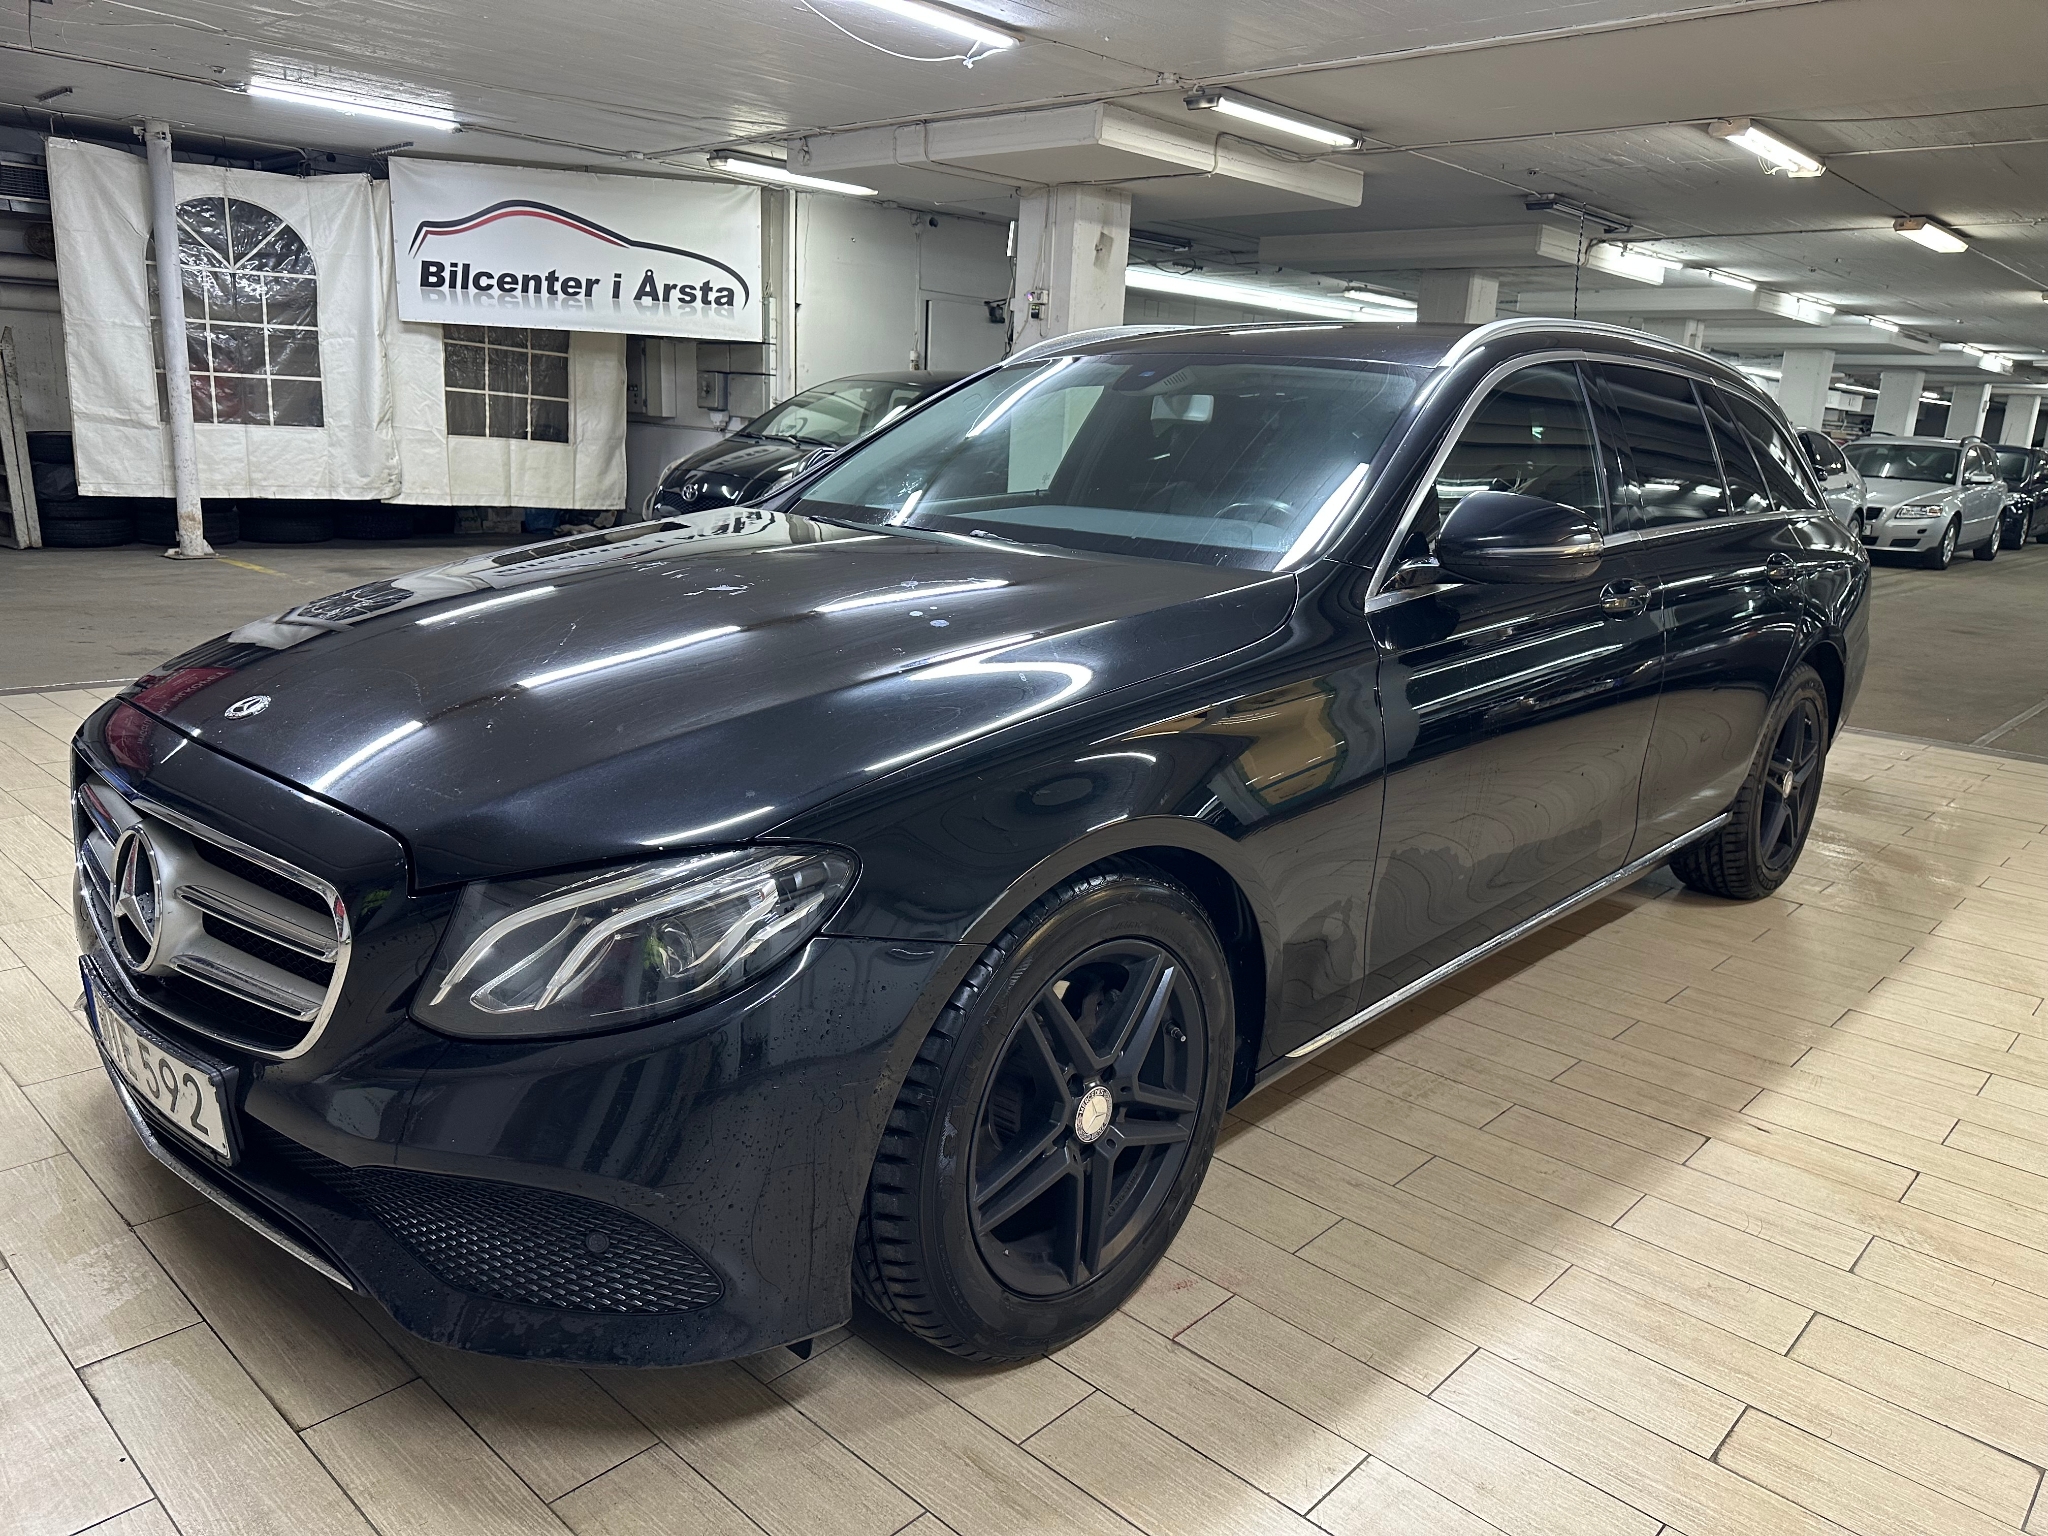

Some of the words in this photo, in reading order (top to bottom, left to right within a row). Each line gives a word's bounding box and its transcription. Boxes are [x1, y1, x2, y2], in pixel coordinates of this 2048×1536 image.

[420, 260, 600, 299] Bilcenter
[611, 272, 622, 299] i
[633, 268, 735, 307] Årsta
[136, 1036, 210, 1137] 592
